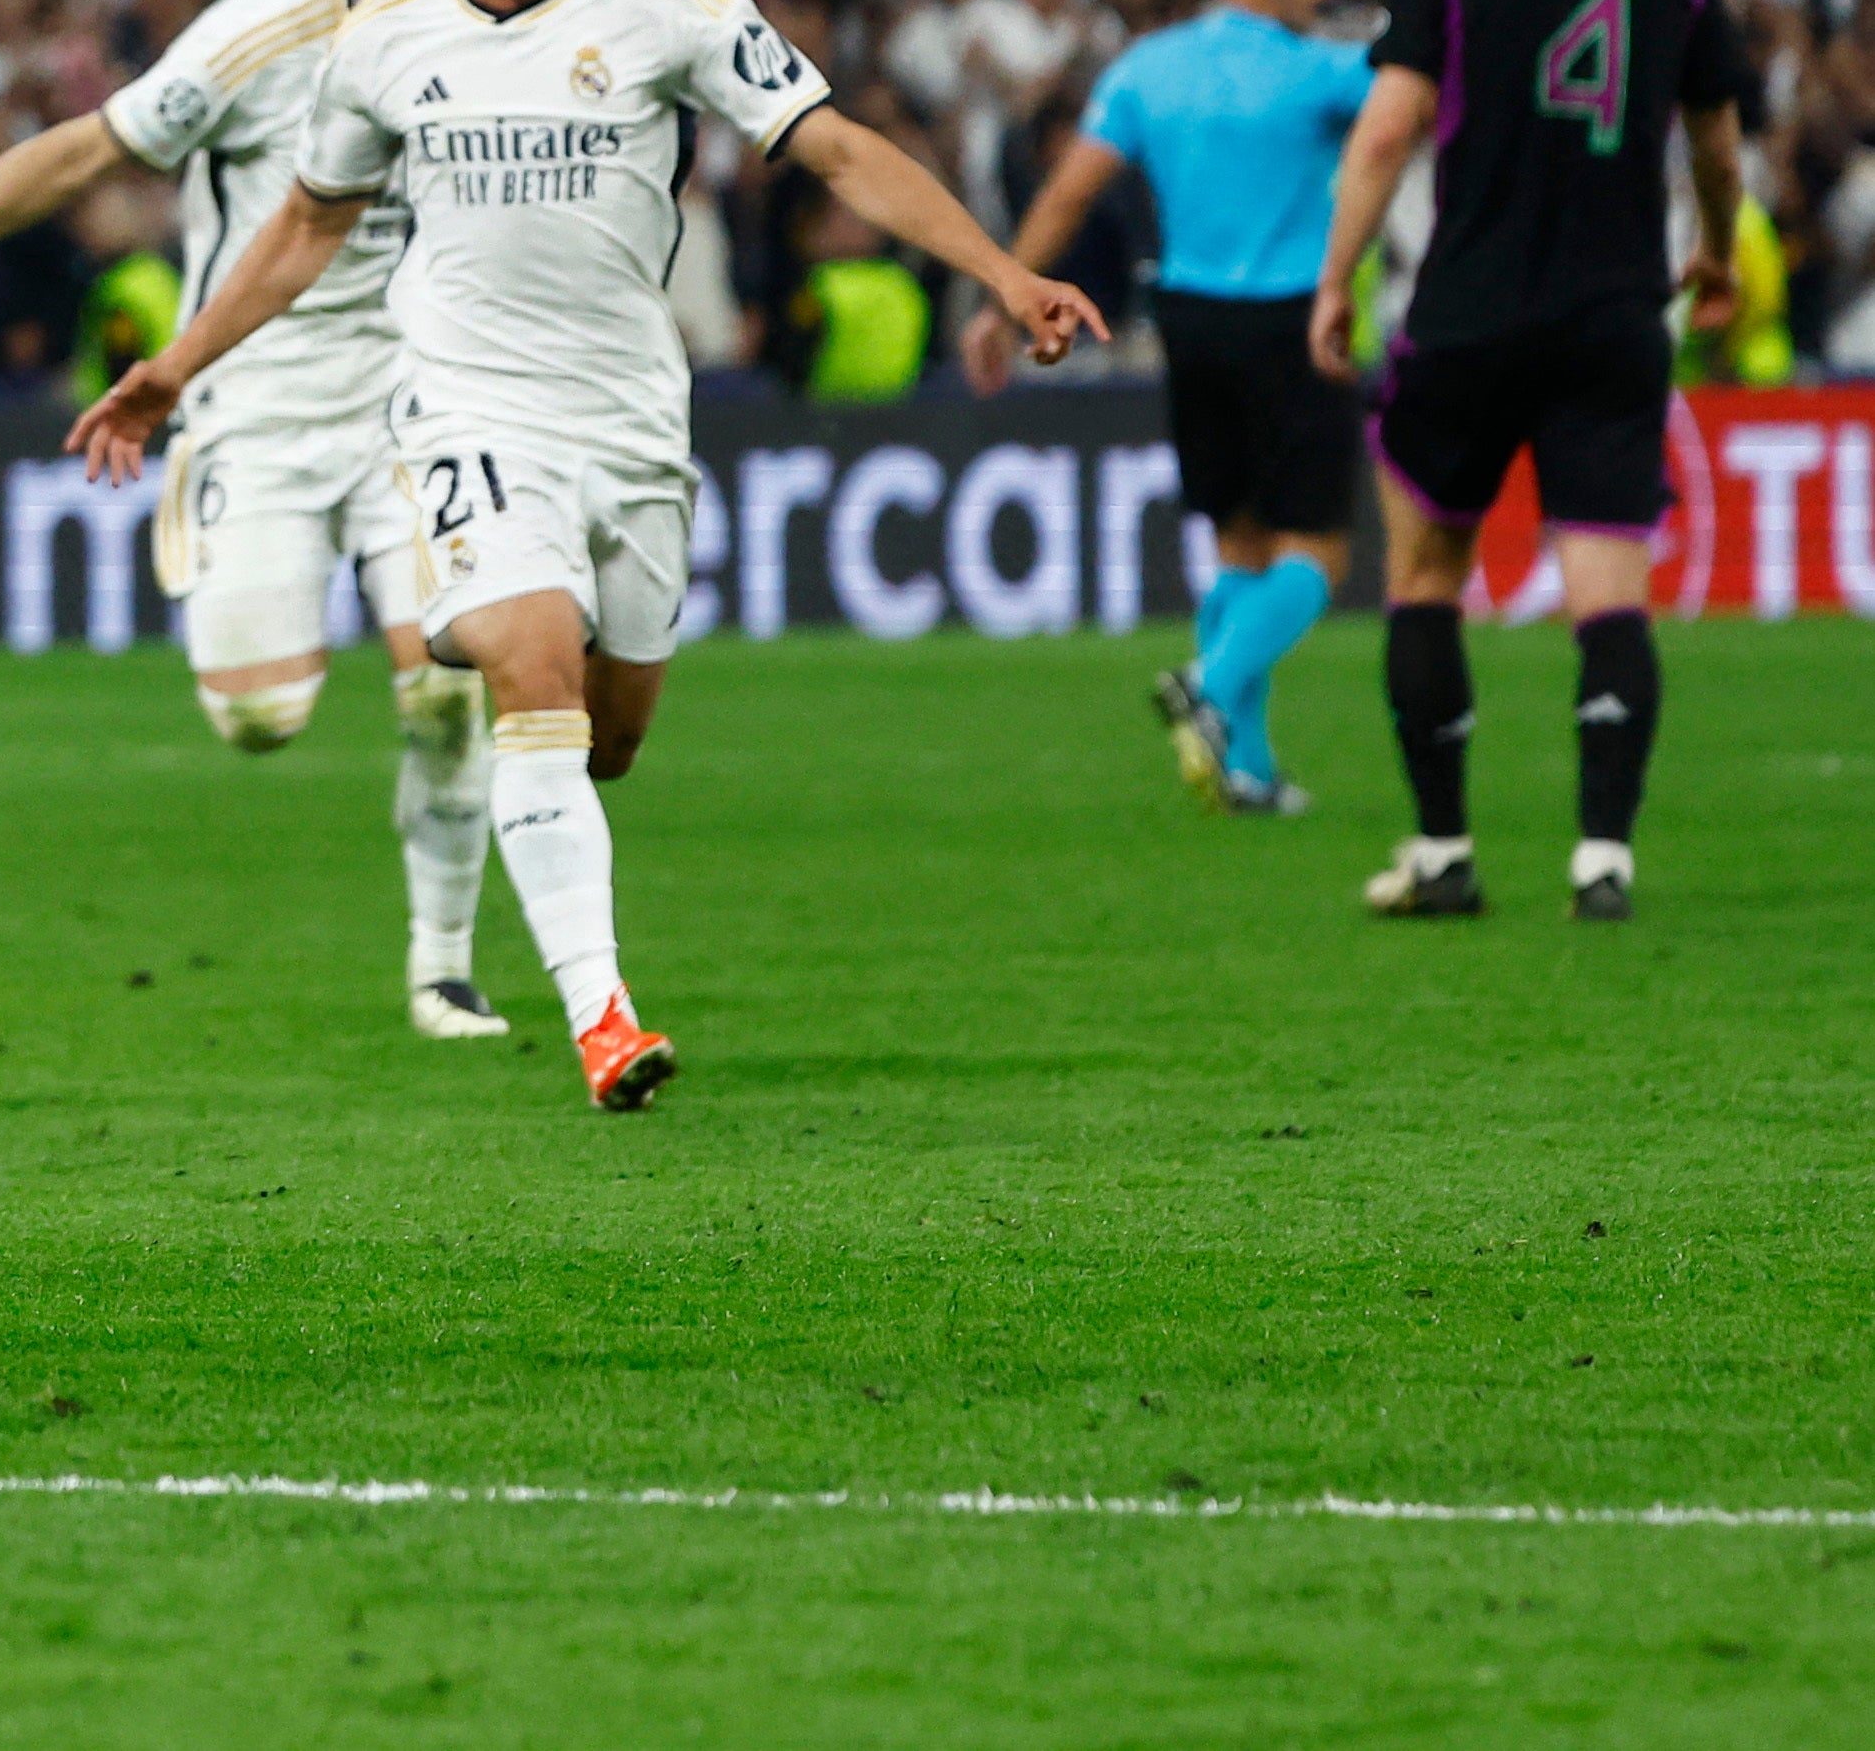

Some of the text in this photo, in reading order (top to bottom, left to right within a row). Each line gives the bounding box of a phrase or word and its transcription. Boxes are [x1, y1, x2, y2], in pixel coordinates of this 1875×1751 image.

[419, 115, 622, 162] Emirates
[452, 164, 597, 205] FLY BETTER
[422, 450, 507, 541] 21
